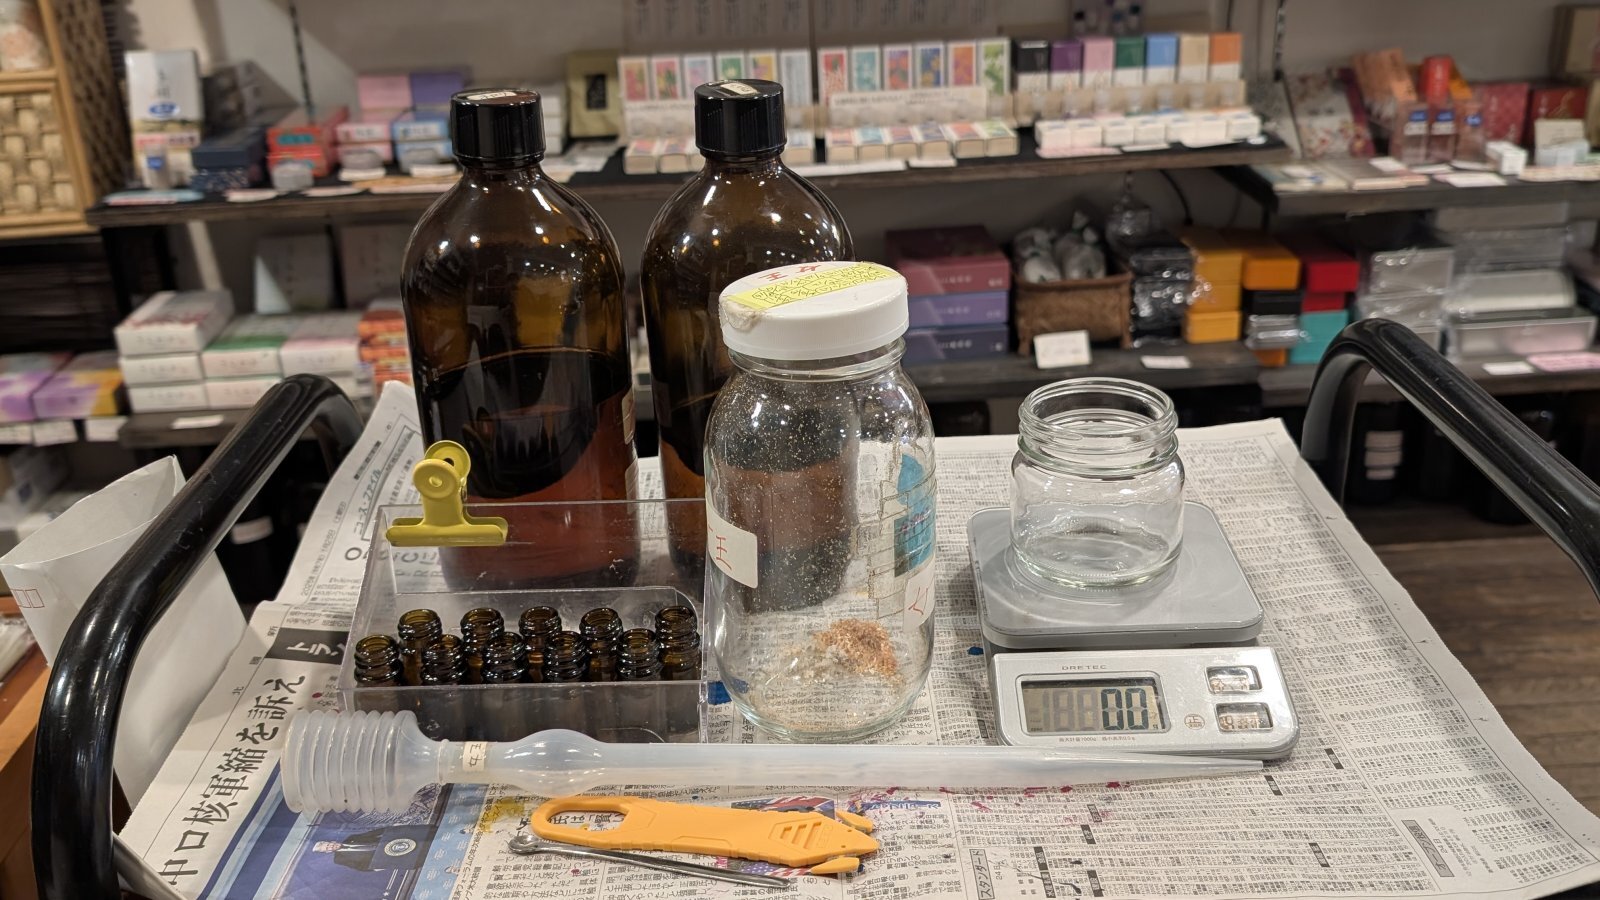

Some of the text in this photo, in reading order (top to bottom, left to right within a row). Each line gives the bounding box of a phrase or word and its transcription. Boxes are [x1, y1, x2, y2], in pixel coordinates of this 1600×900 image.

[972, 850, 992, 898] スタンダード
